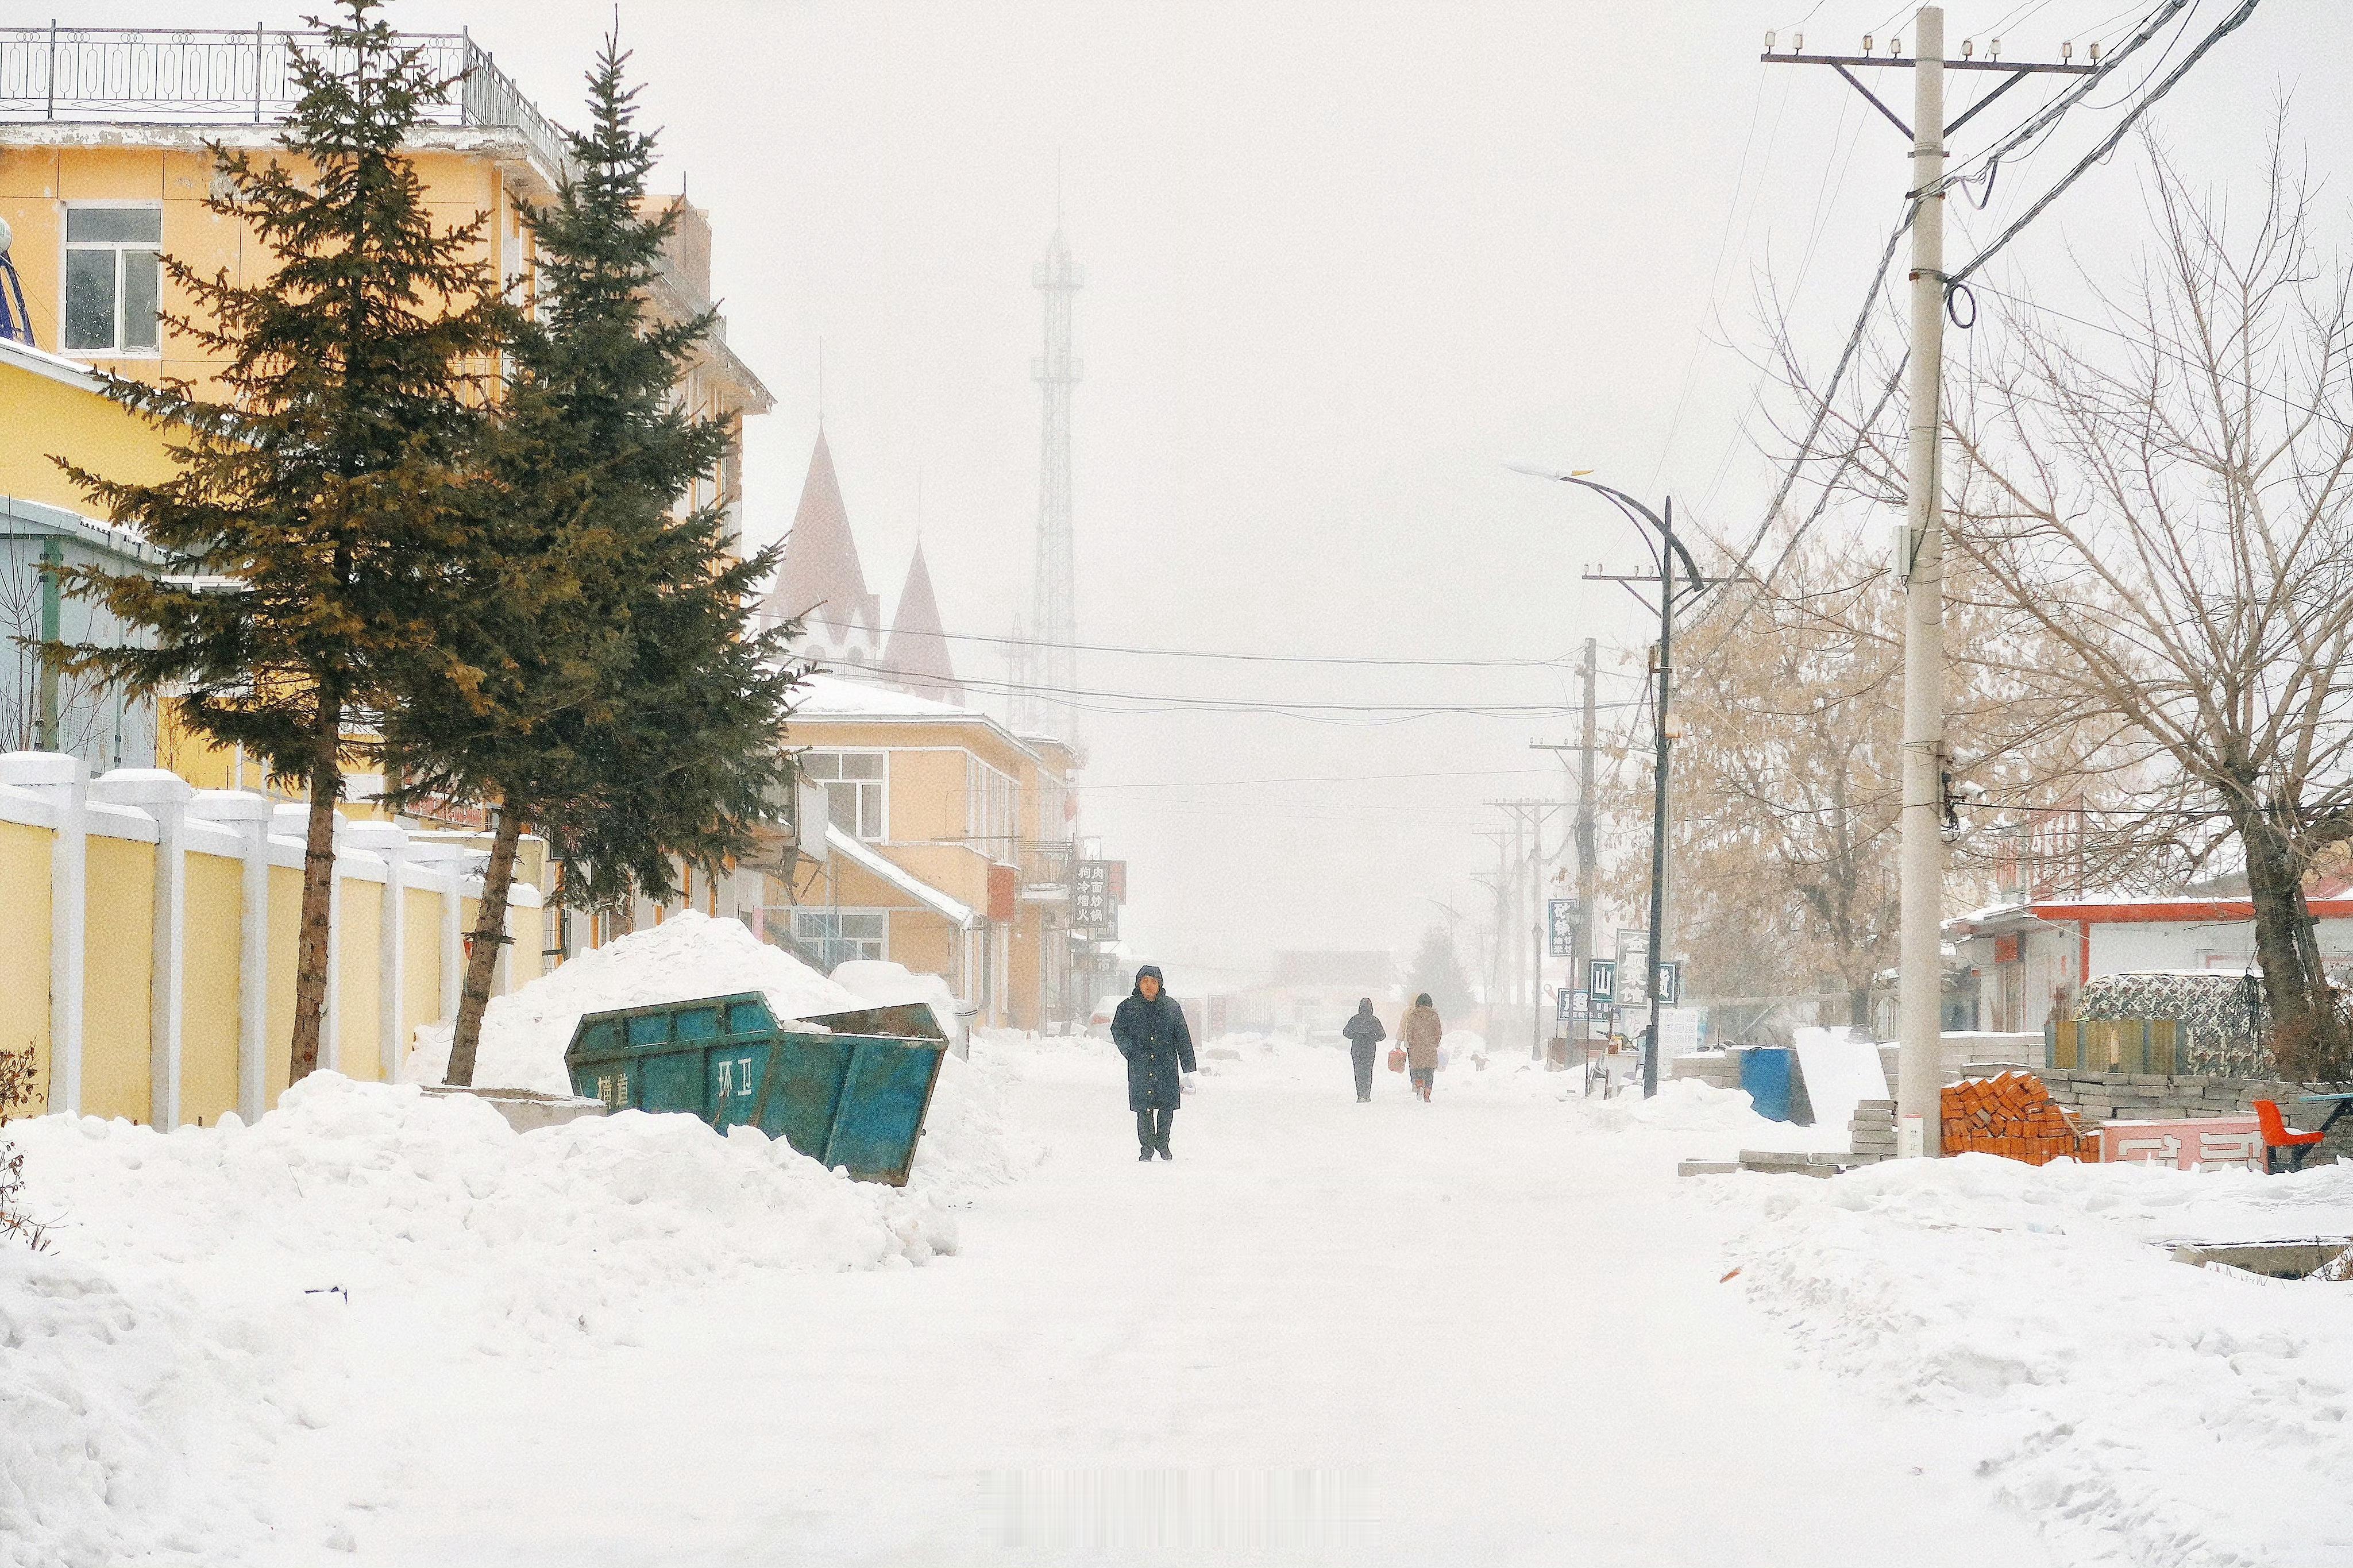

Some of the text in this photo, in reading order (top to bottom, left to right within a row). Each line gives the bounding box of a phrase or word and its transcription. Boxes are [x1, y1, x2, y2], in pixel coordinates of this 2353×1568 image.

[1078, 866, 1104, 879] 狗肉
[1077, 880, 1104, 893] 冷面
[1076, 908, 1103, 922] 火锅
[1907, 1129, 1919, 1158] 禁止
